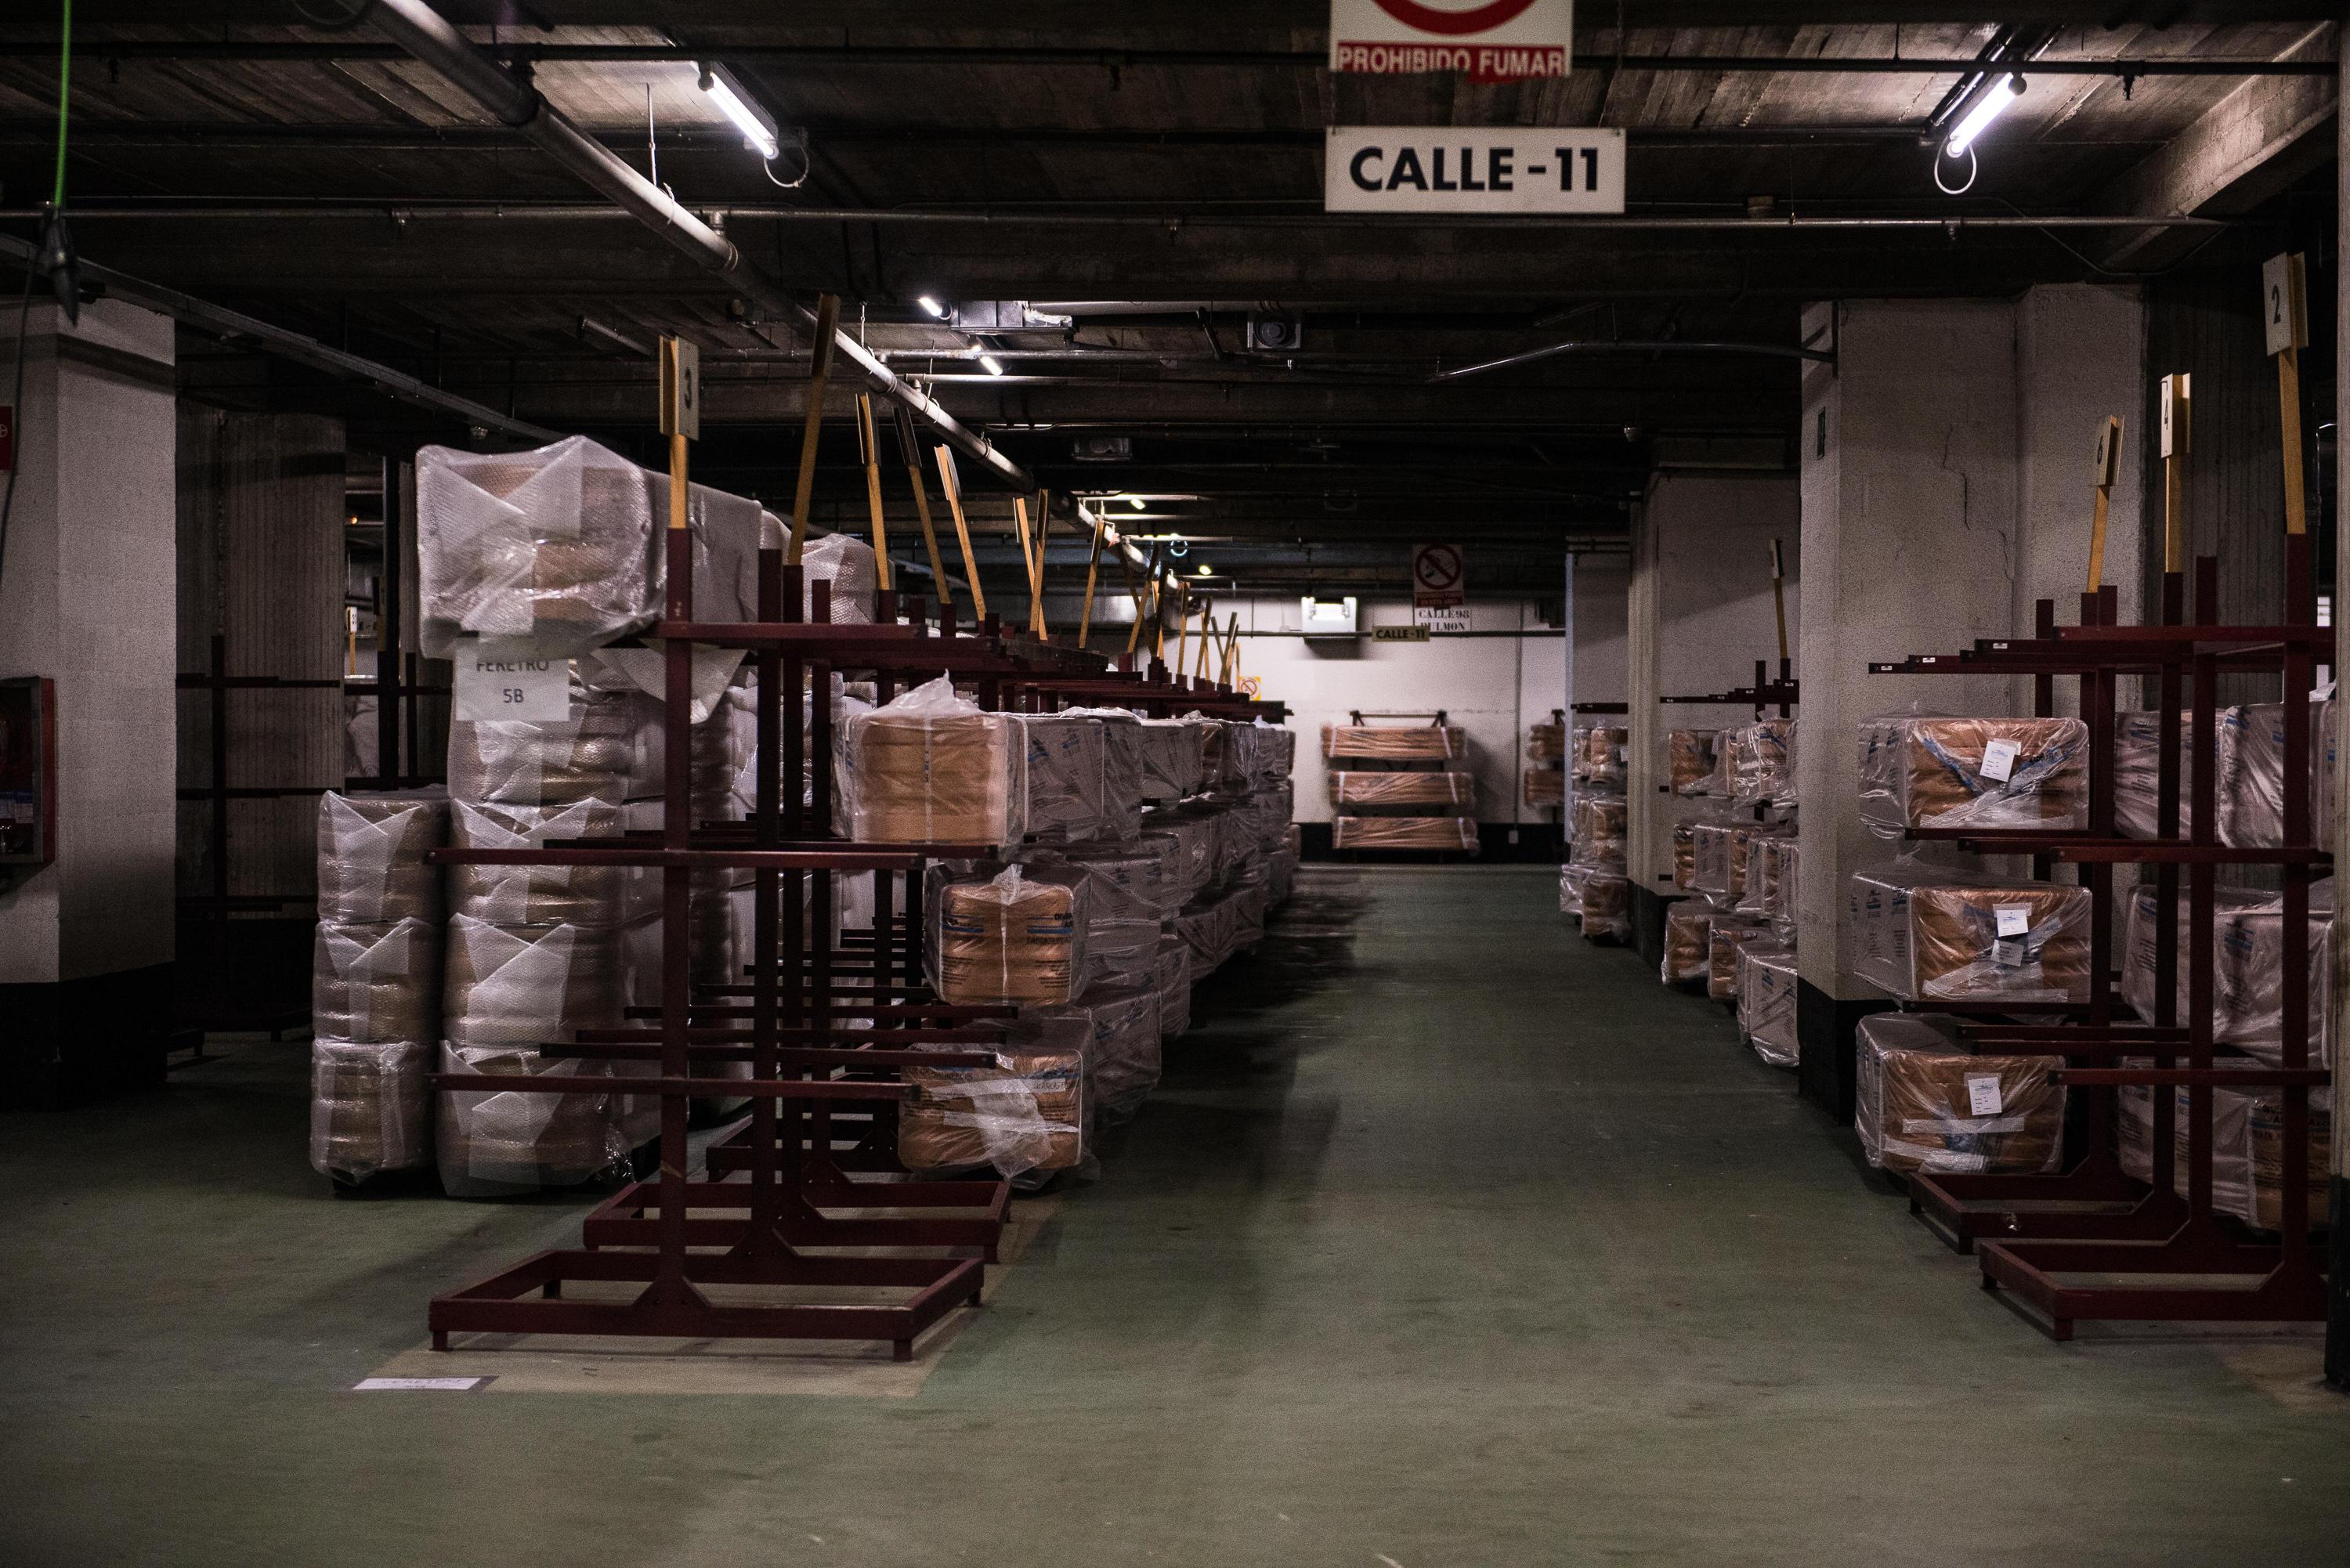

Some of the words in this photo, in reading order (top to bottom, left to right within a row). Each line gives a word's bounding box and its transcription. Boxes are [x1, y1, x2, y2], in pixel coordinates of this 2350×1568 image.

[1338, 46, 1471, 73] PROHIBIDO
[1480, 50, 1564, 76] FUMAR
[2272, 285, 2281, 324] 2
[503, 688, 524, 703] 5B
